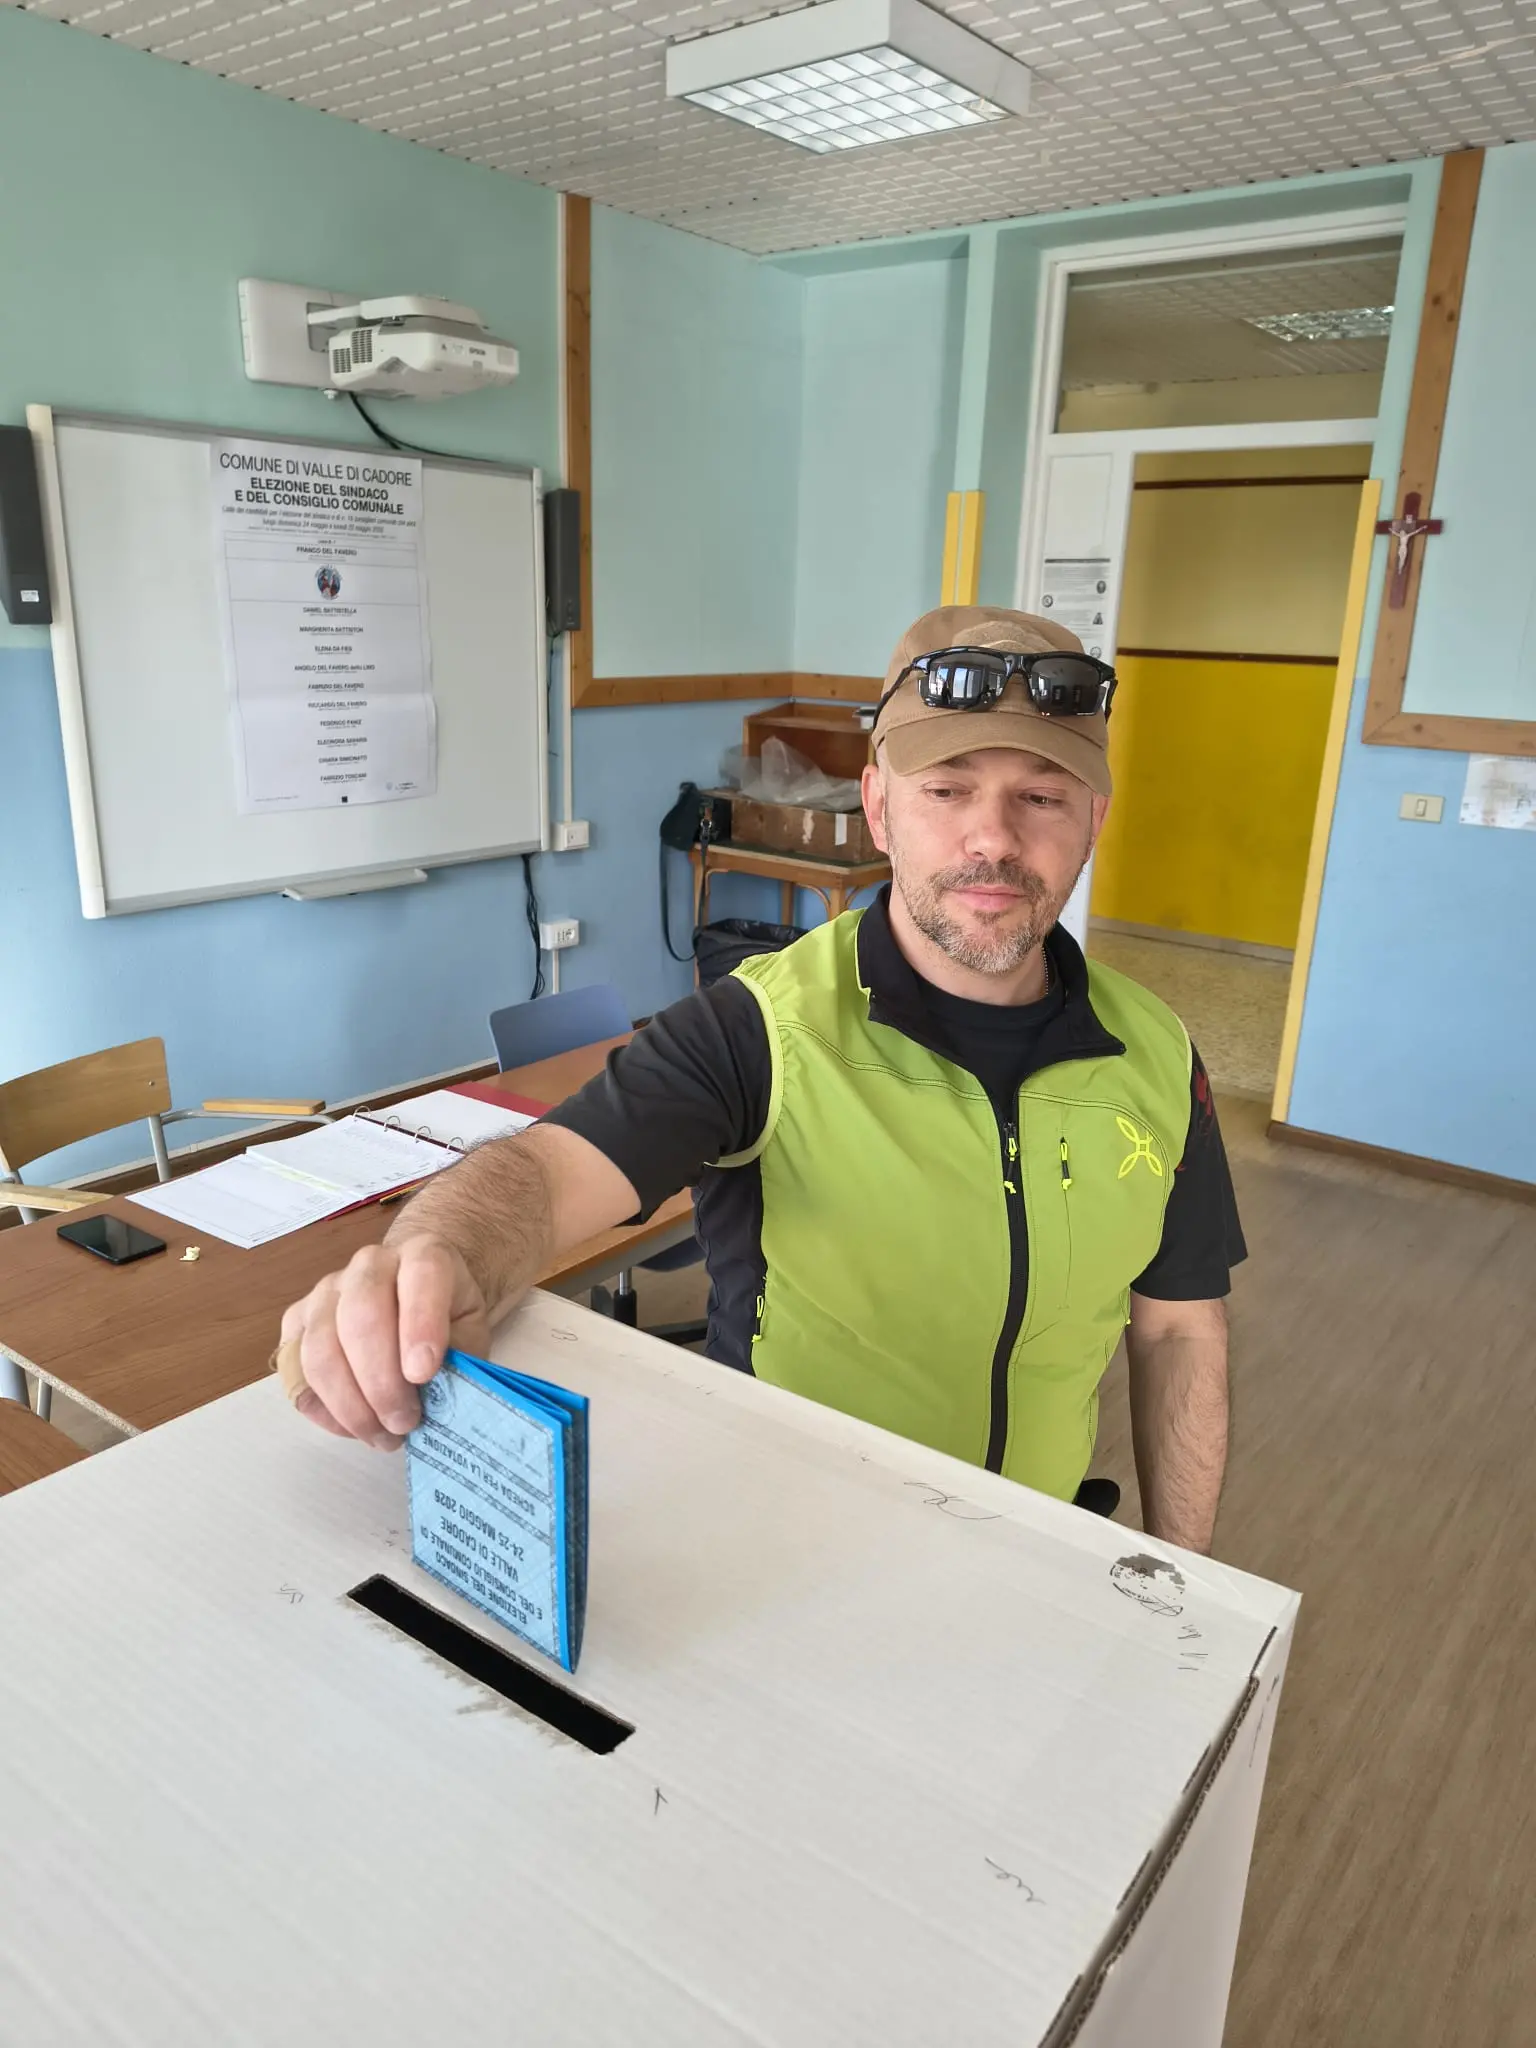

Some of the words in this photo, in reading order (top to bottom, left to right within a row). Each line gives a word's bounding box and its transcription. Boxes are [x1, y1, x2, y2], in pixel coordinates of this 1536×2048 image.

[219, 452, 283, 474] COMUNE
[286, 459, 299, 475] DI
[301, 461, 344, 480] VALLE
[346, 465, 359, 482] DI
[362, 467, 413, 487] CADORE
[234, 489, 244, 502] E
[246, 490, 270, 504] DEL
[273, 493, 340, 510] CONSIGLIO
[342, 498, 405, 515] COMUNALE
[250, 477, 311, 495] ELEZIONE
[313, 482, 337, 497] DEL
[339, 485, 389, 501] SINDACO
[423, 1432, 468, 1469] VOTAZIONE
[470, 1463, 481, 1478] LA
[483, 1471, 499, 1491] PER
[434, 1488, 457, 1513] 2026
[501, 1483, 536, 1516] SCHEDA
[440, 1515, 477, 1551] CADORE
[459, 1504, 496, 1541] MAGGIO
[430, 1531, 472, 1570] COMUNALE
[479, 1542, 488, 1560] DI
[499, 1532, 524, 1562] 24-25
[436, 1551, 469, 1584] SINDACO
[491, 1551, 519, 1582] VALLE
[471, 1576, 486, 1596] DEL
[474, 1563, 516, 1602] CONSIGLIO
[488, 1588, 527, 1625] ELEZIONE
[519, 1594, 535, 1615] DEL
[536, 1608, 543, 1620] E
